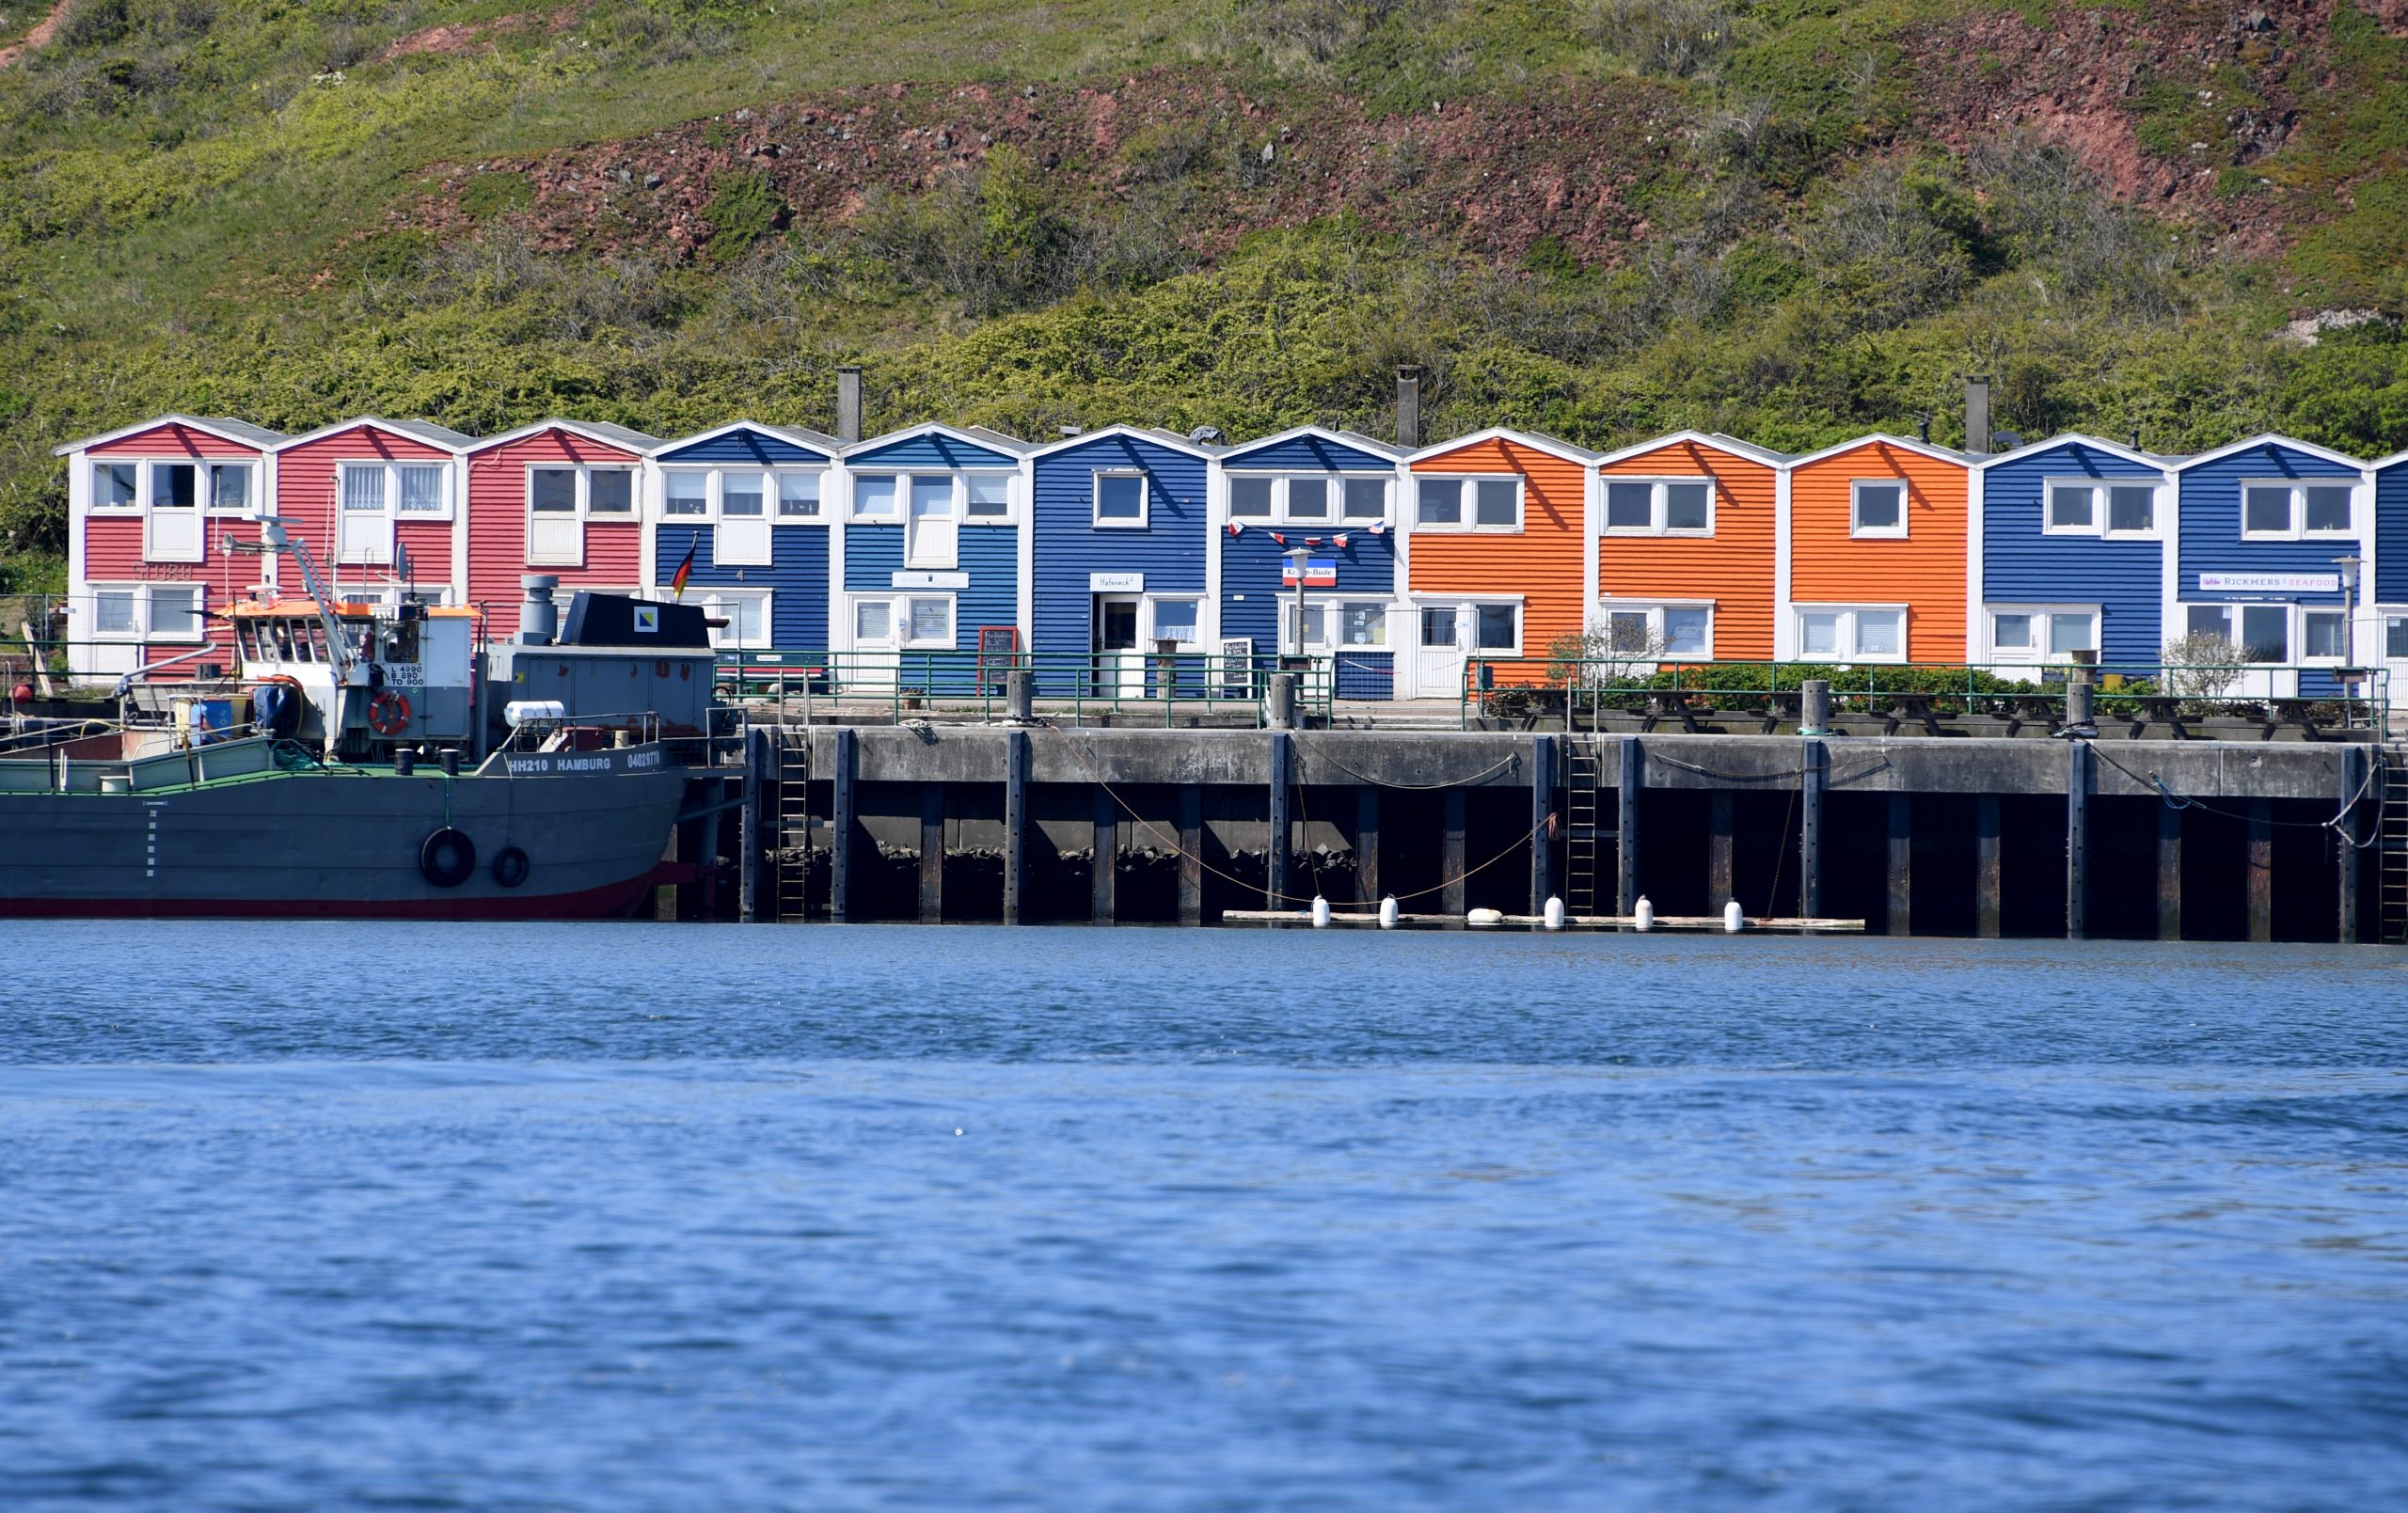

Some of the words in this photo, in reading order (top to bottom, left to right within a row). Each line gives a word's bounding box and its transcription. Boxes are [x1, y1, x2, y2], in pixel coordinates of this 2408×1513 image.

[736, 569, 744, 581] 4
[2224, 577, 2281, 586] RICKMERS
[2289, 578, 2337, 587] SEAFOOD
[509, 760, 548, 772] HH210
[558, 758, 611, 771] HAMBURG
